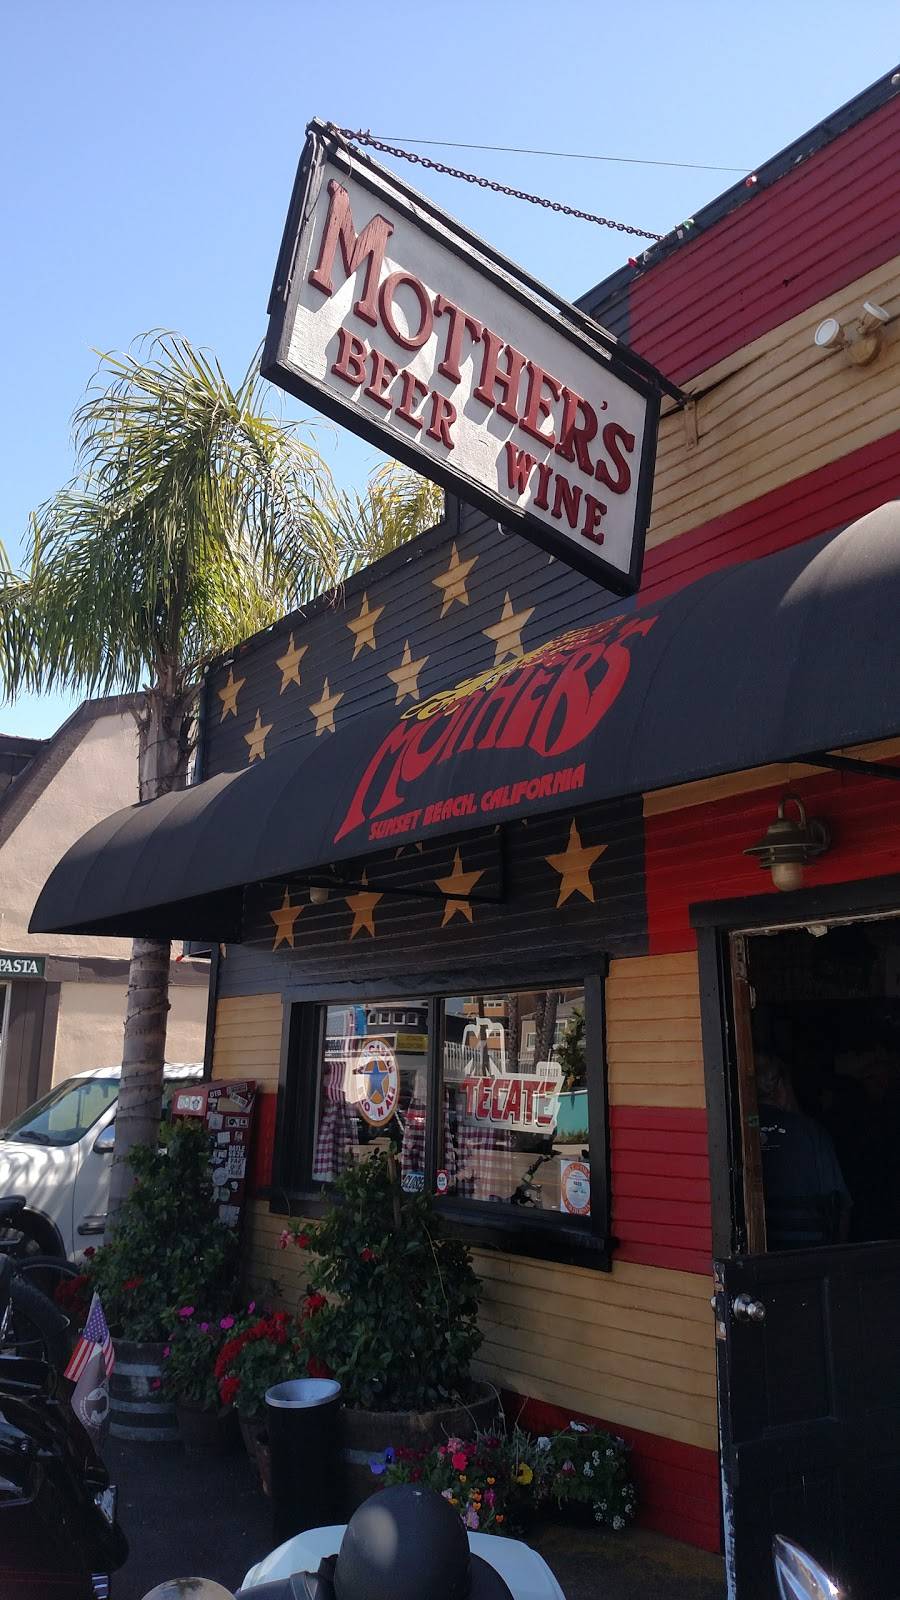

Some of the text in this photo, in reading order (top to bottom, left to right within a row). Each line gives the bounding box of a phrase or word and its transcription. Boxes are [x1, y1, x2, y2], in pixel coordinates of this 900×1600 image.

[308, 178, 634, 494] MOTHER'S
[332, 328, 607, 546] BEER WINE
[368, 808, 423, 841] SUNSET
[480, 762, 586, 811] CALIFORNIA
[0, 959, 38, 973] PASTA
[460, 1076, 558, 1126] TECATE
